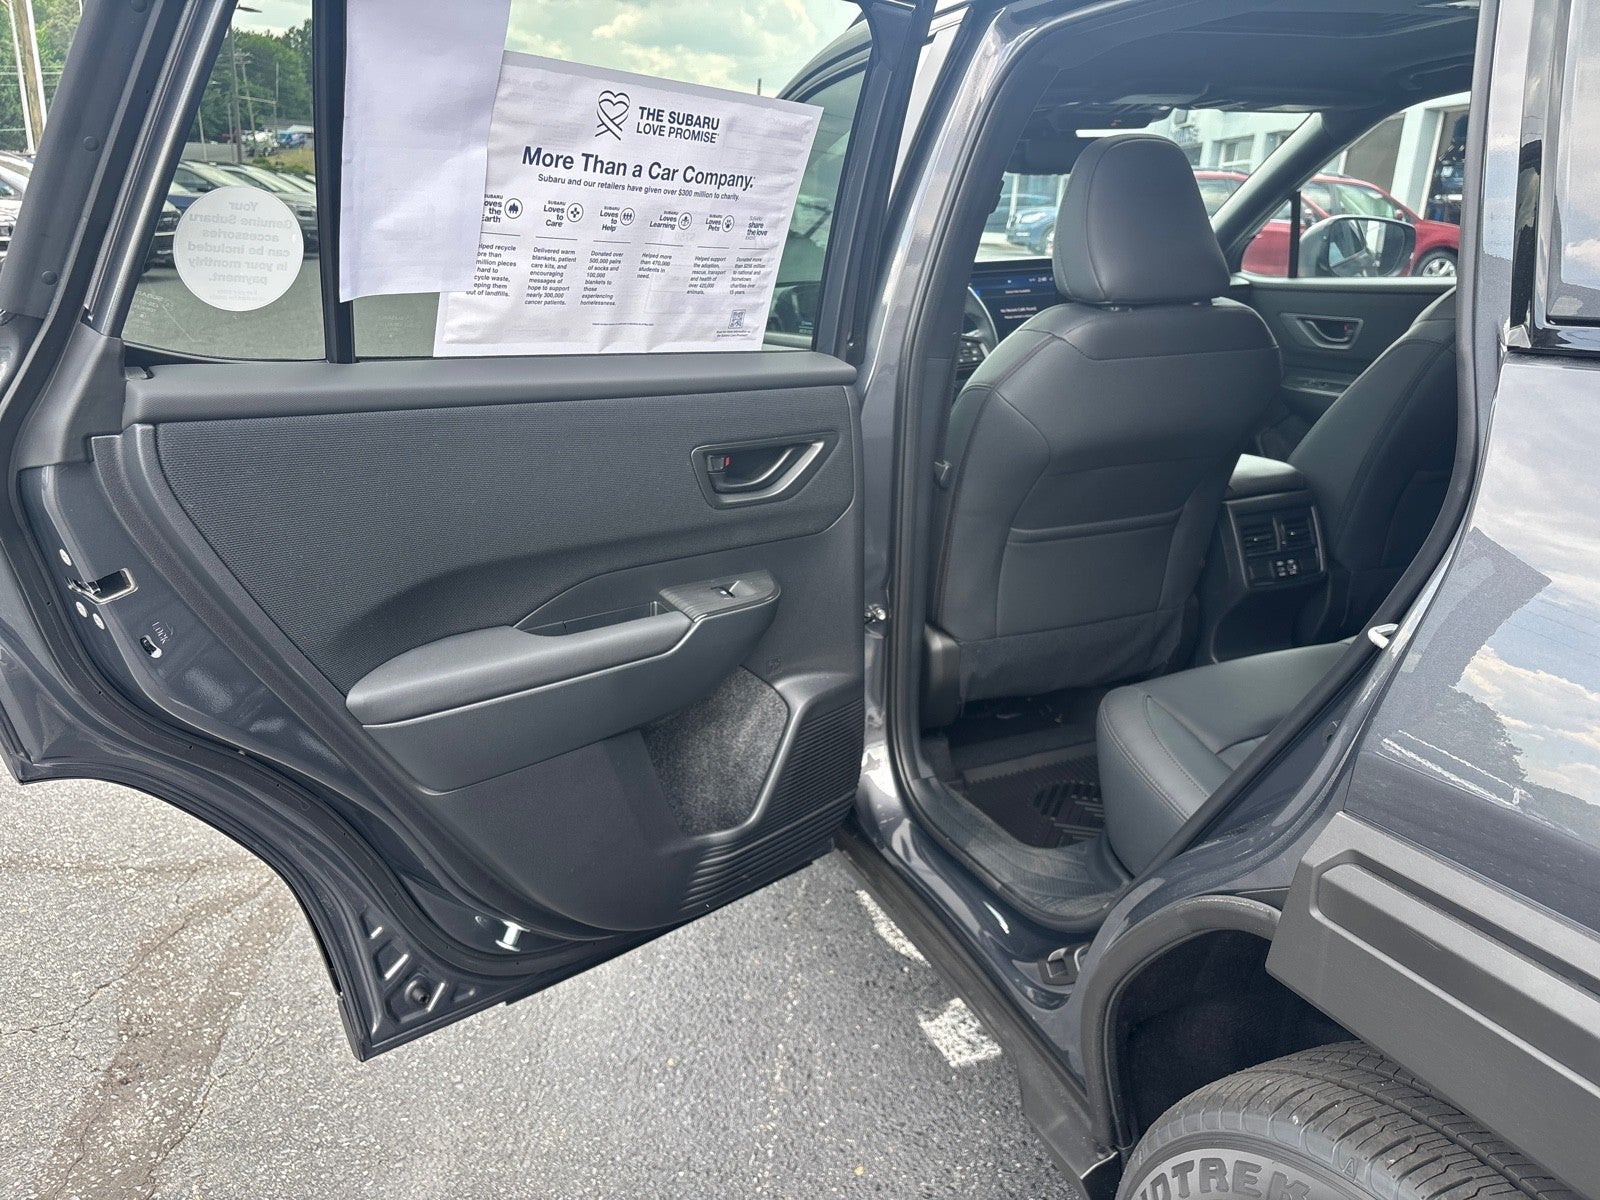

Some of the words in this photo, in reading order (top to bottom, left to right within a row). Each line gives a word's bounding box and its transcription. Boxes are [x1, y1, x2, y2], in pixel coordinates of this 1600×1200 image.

[639, 106, 664, 122] THE
[668, 112, 719, 130] SUBARU
[636, 122, 665, 136] LOVE
[522, 146, 574, 169] More
[582, 153, 627, 176] Than
[632, 164, 642, 178] a
[648, 162, 679, 182] Car
[538, 174, 565, 184] Subaru
[568, 177, 582, 186] and
[598, 180, 625, 191] retailers
[627, 183, 642, 192] have
[644, 186, 662, 195] given
[678, 188, 692, 197] $300
[694, 190, 712, 198] million
[721, 192, 739, 201] charity.
[544, 205, 565, 213] Loves
[600, 210, 619, 218] Loves
[602, 224, 616, 232] Help
[650, 221, 676, 230] Learning
[1141, 1158, 1311, 1200] DTREK
